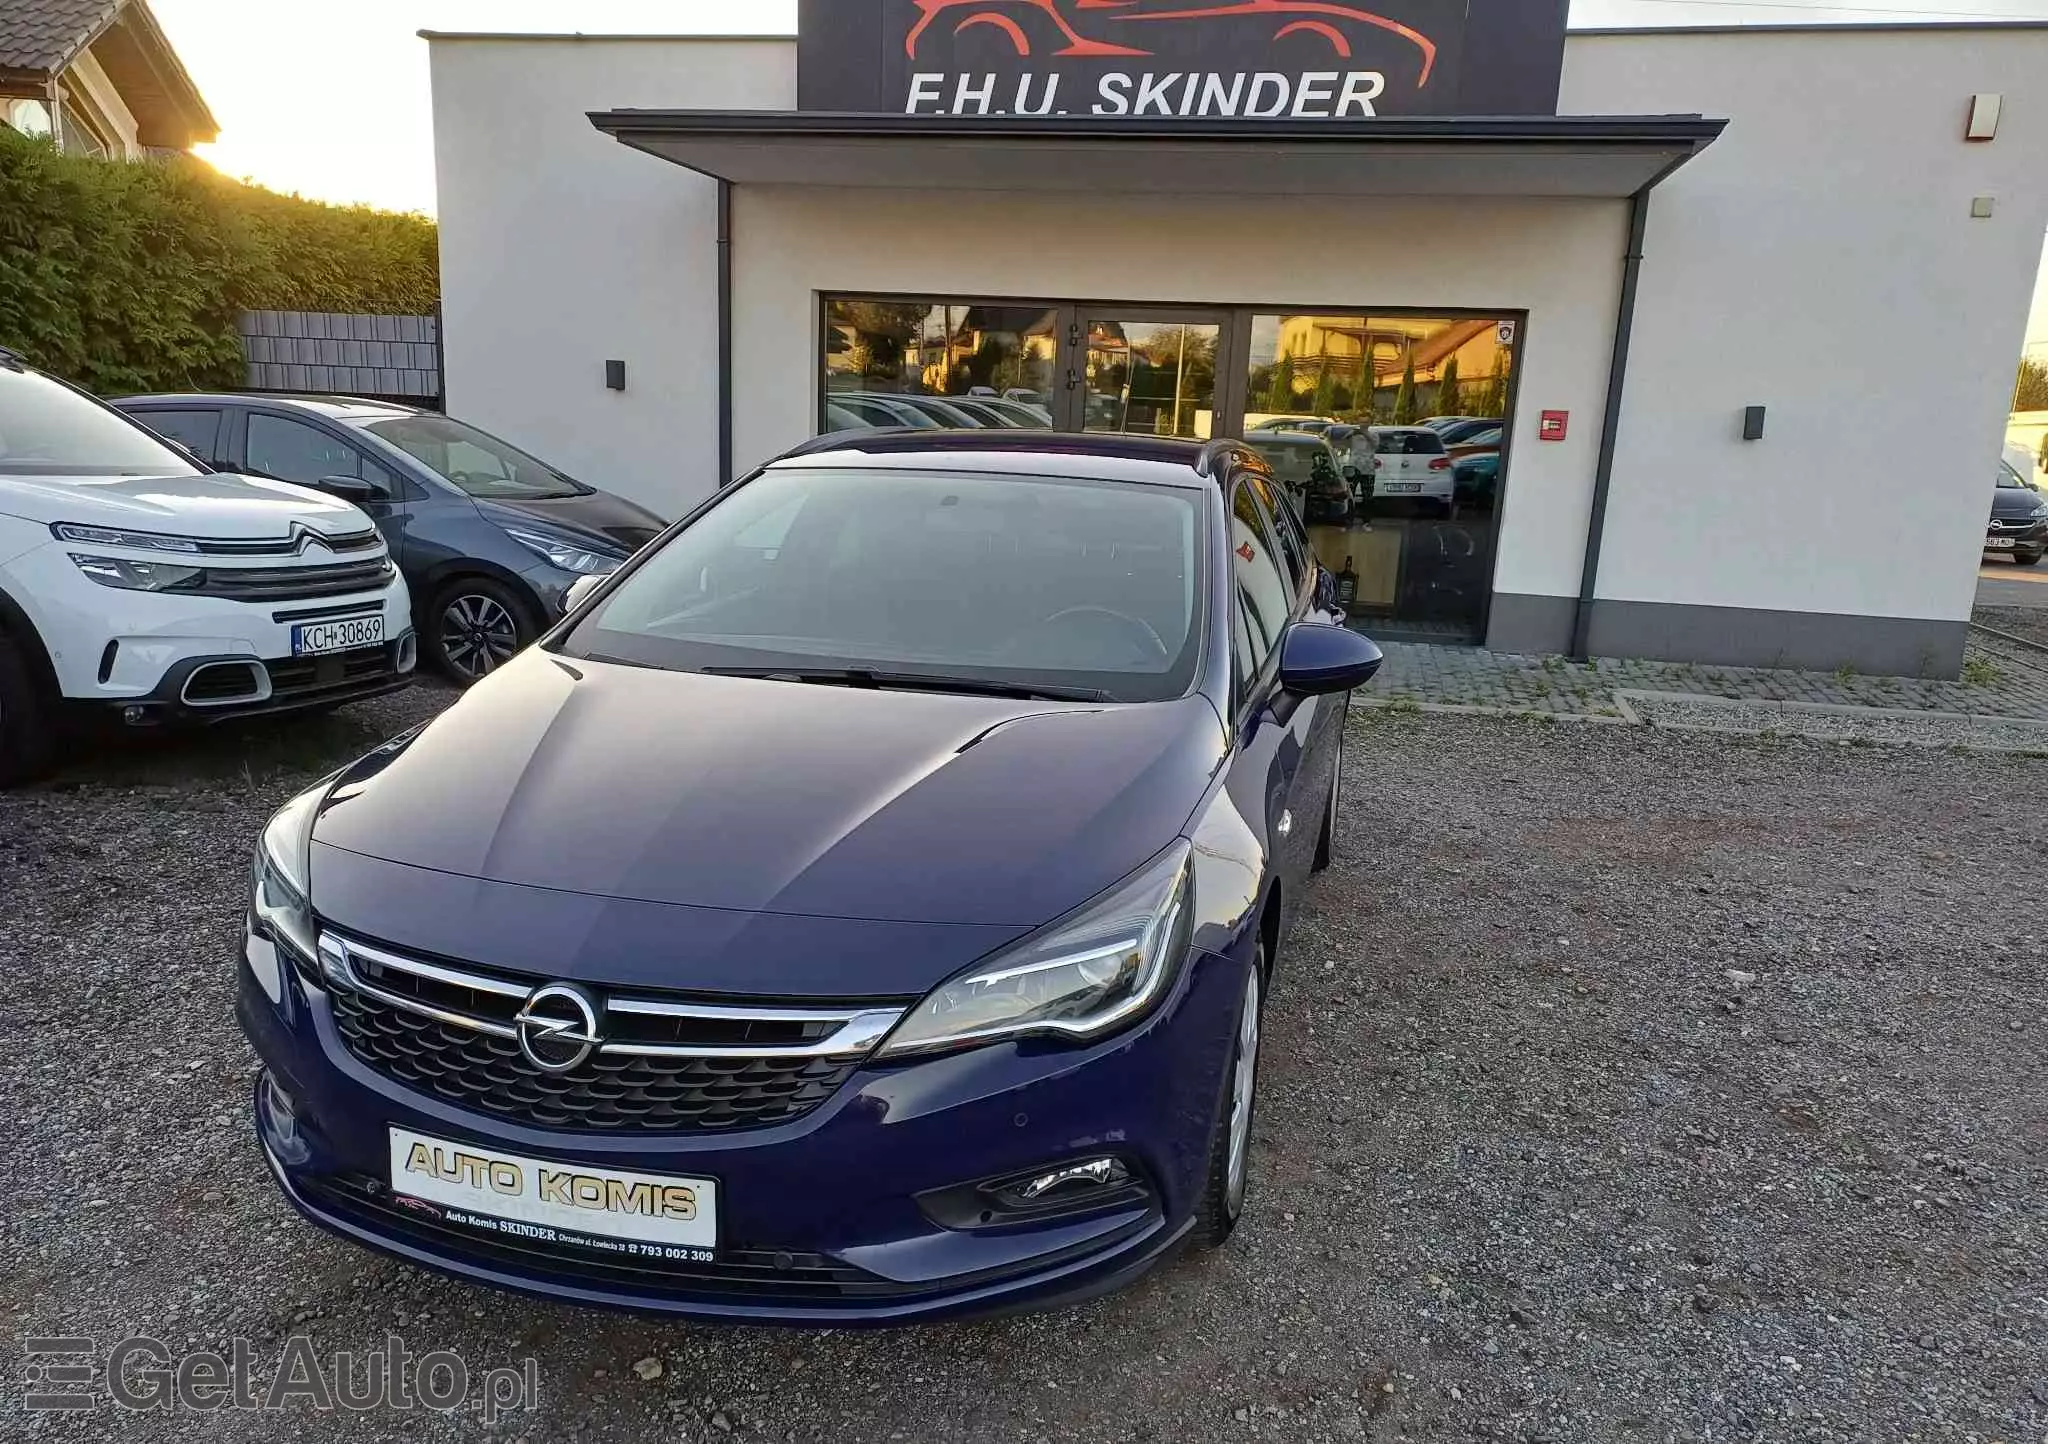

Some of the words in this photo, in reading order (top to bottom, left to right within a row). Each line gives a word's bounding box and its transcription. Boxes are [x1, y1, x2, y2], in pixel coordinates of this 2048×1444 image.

[905, 72, 1067, 115] F.H.U.
[1093, 71, 1385, 117] SKINDER
[303, 625, 334, 651] KCH
[339, 619, 381, 645] 30869
[405, 1142, 524, 1196] AUTO
[539, 1168, 698, 1221] KOMIS
[446, 1210, 467, 1223] Auto
[468, 1215, 497, 1229] Komis
[500, 1221, 557, 1241] SKINDER
[640, 1244, 663, 1257] 793
[665, 1248, 688, 1260] 002
[691, 1250, 714, 1262] 309
